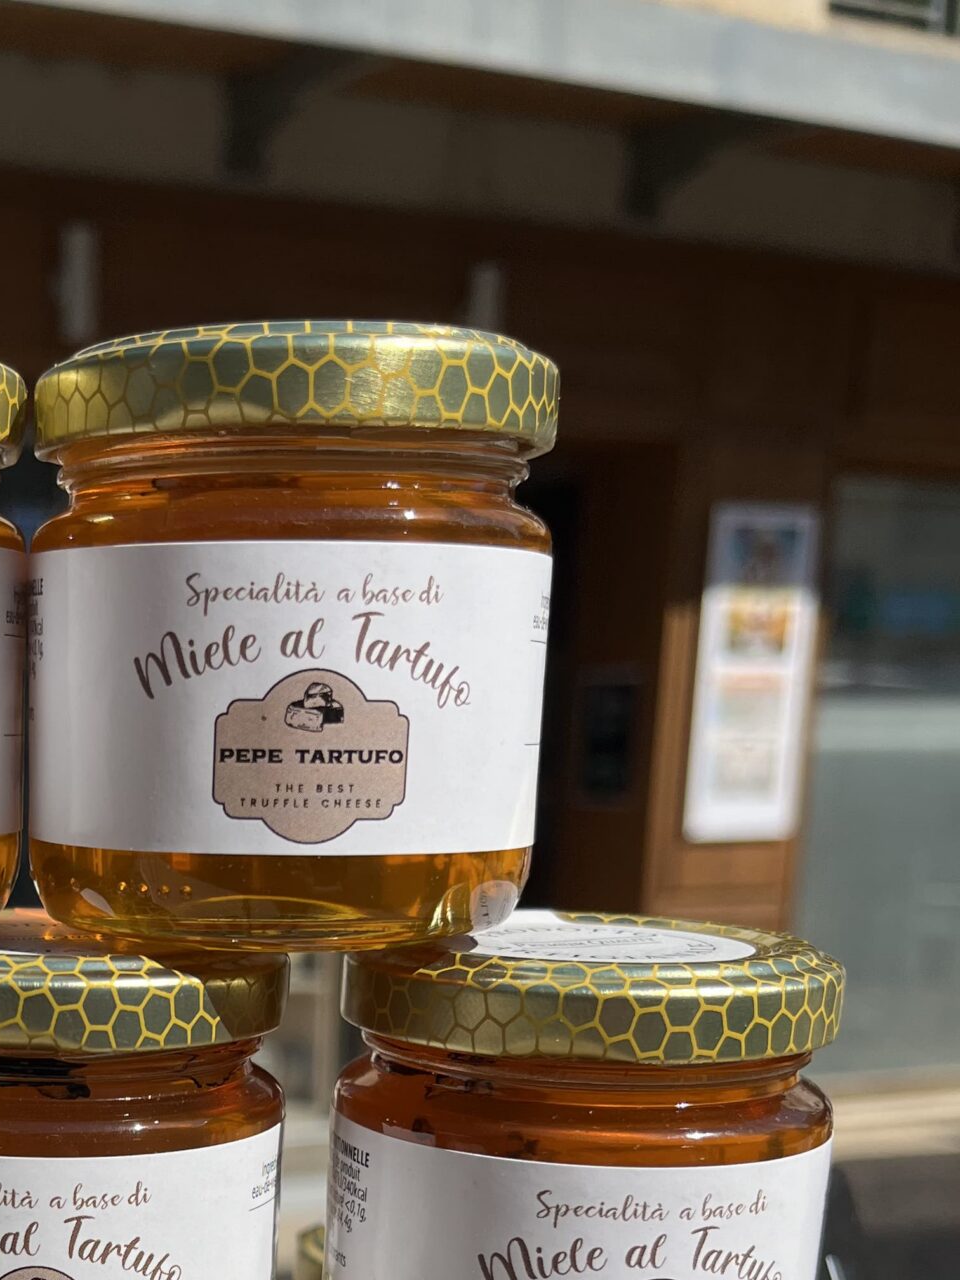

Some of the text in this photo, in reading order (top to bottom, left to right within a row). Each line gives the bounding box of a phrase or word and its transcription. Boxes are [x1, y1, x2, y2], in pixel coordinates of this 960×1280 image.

[186, 572, 444, 615] Specialità a base di
[134, 625, 262, 699] Miele
[280, 618, 325, 659] al
[351, 611, 471, 709] Tartufo
[219, 747, 403, 765] PEPE TARTUFO
[240, 798, 382, 809] TRUFFLE CHEESE
[275, 783, 355, 794] THE BEST
[49, 1192, 67, 1209] a
[73, 1181, 121, 1211] base
[126, 1181, 151, 1205] di
[536, 1189, 768, 1227] Specialità a base di
[0, 1220, 40, 1256] al
[625, 1234, 667, 1270] al
